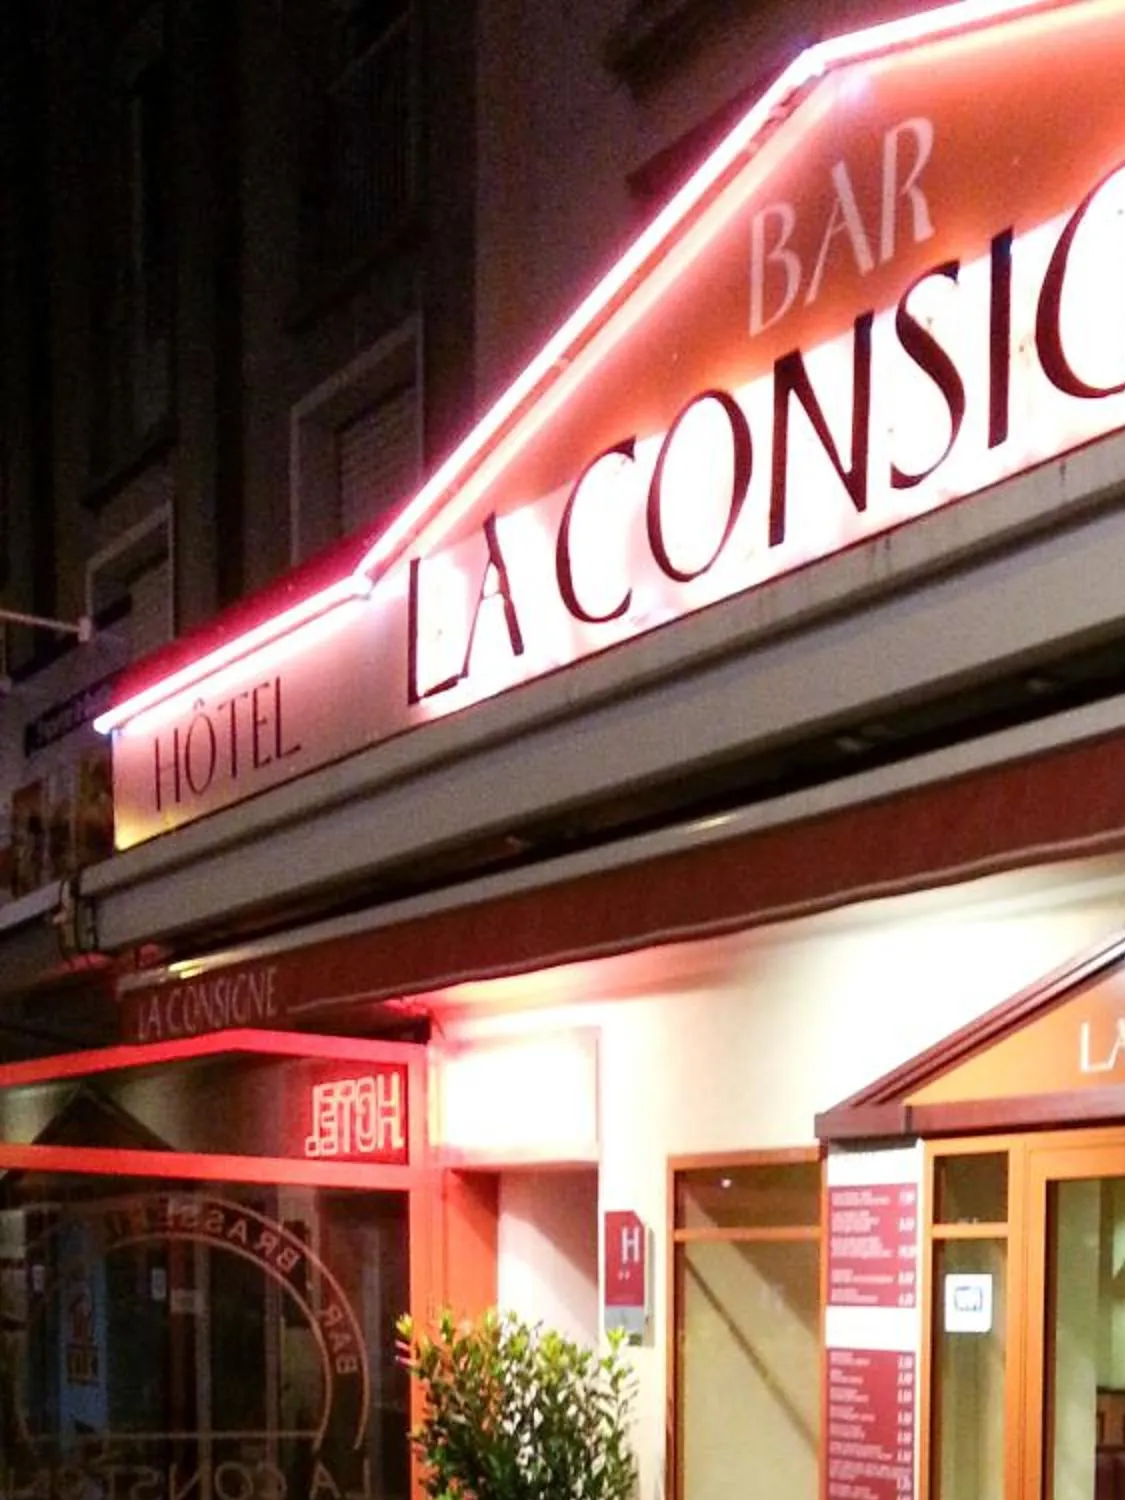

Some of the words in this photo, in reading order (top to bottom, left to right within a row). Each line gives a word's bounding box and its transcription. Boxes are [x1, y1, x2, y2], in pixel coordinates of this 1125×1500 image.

[745, 115, 937, 338] BAR
[407, 512, 526, 706] LA
[152, 676, 302, 813] HÔTEL
[166, 965, 278, 1034] CONSIGNE
[620, 1225, 641, 1264] H
